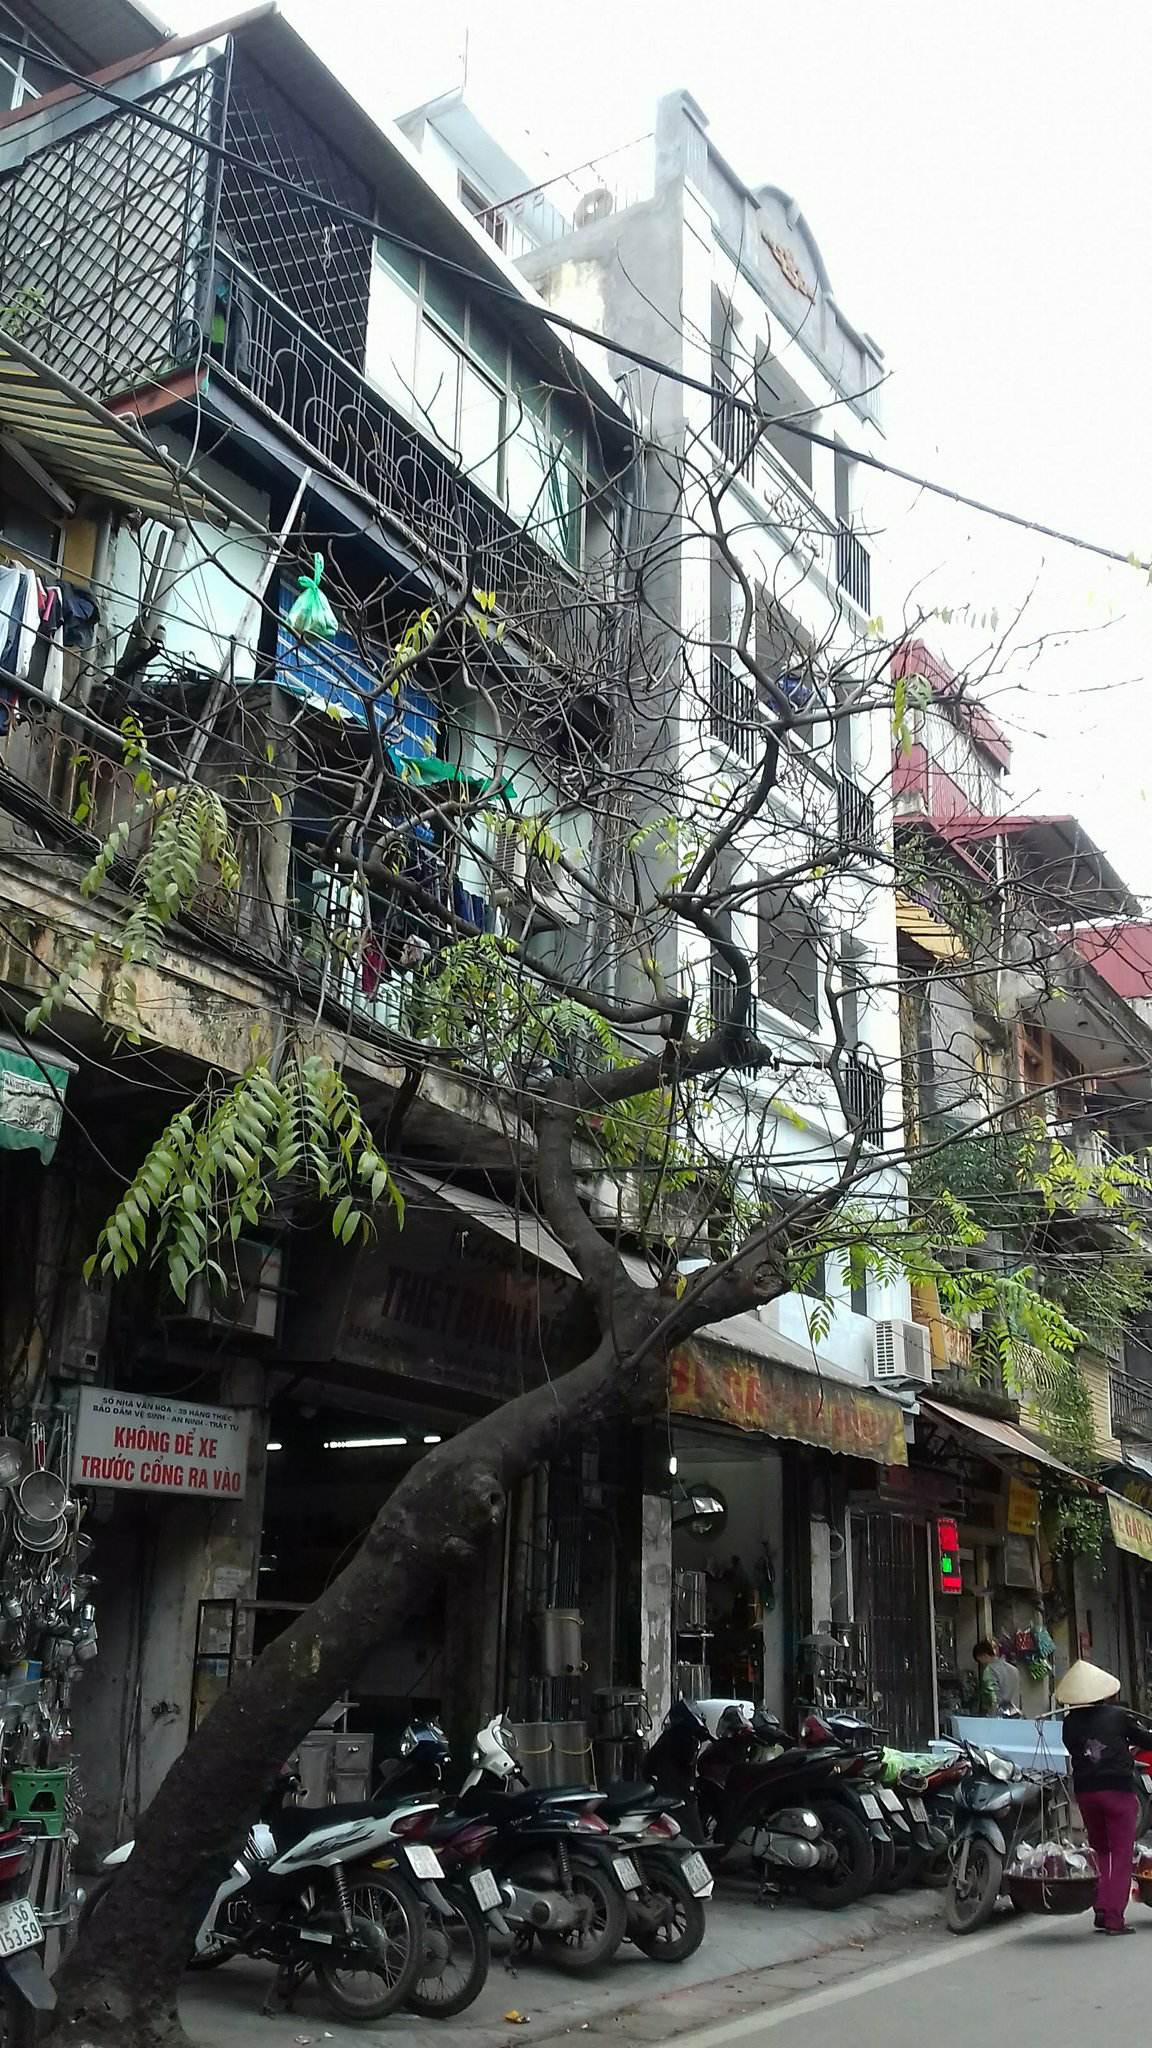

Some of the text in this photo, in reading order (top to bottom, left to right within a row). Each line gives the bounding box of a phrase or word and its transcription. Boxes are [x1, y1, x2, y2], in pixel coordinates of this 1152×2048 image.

[115, 1399, 135, 1408] NHÀ
[147, 1413, 166, 1422] SINH
[171, 1416, 184, 1425] AN
[184, 1417, 204, 1427] NINH
[114, 1425, 218, 1458] KHÔNG ĐỂ XE
[81, 1454, 240, 1491] TRƯỚC CỔNG RA VÀO
